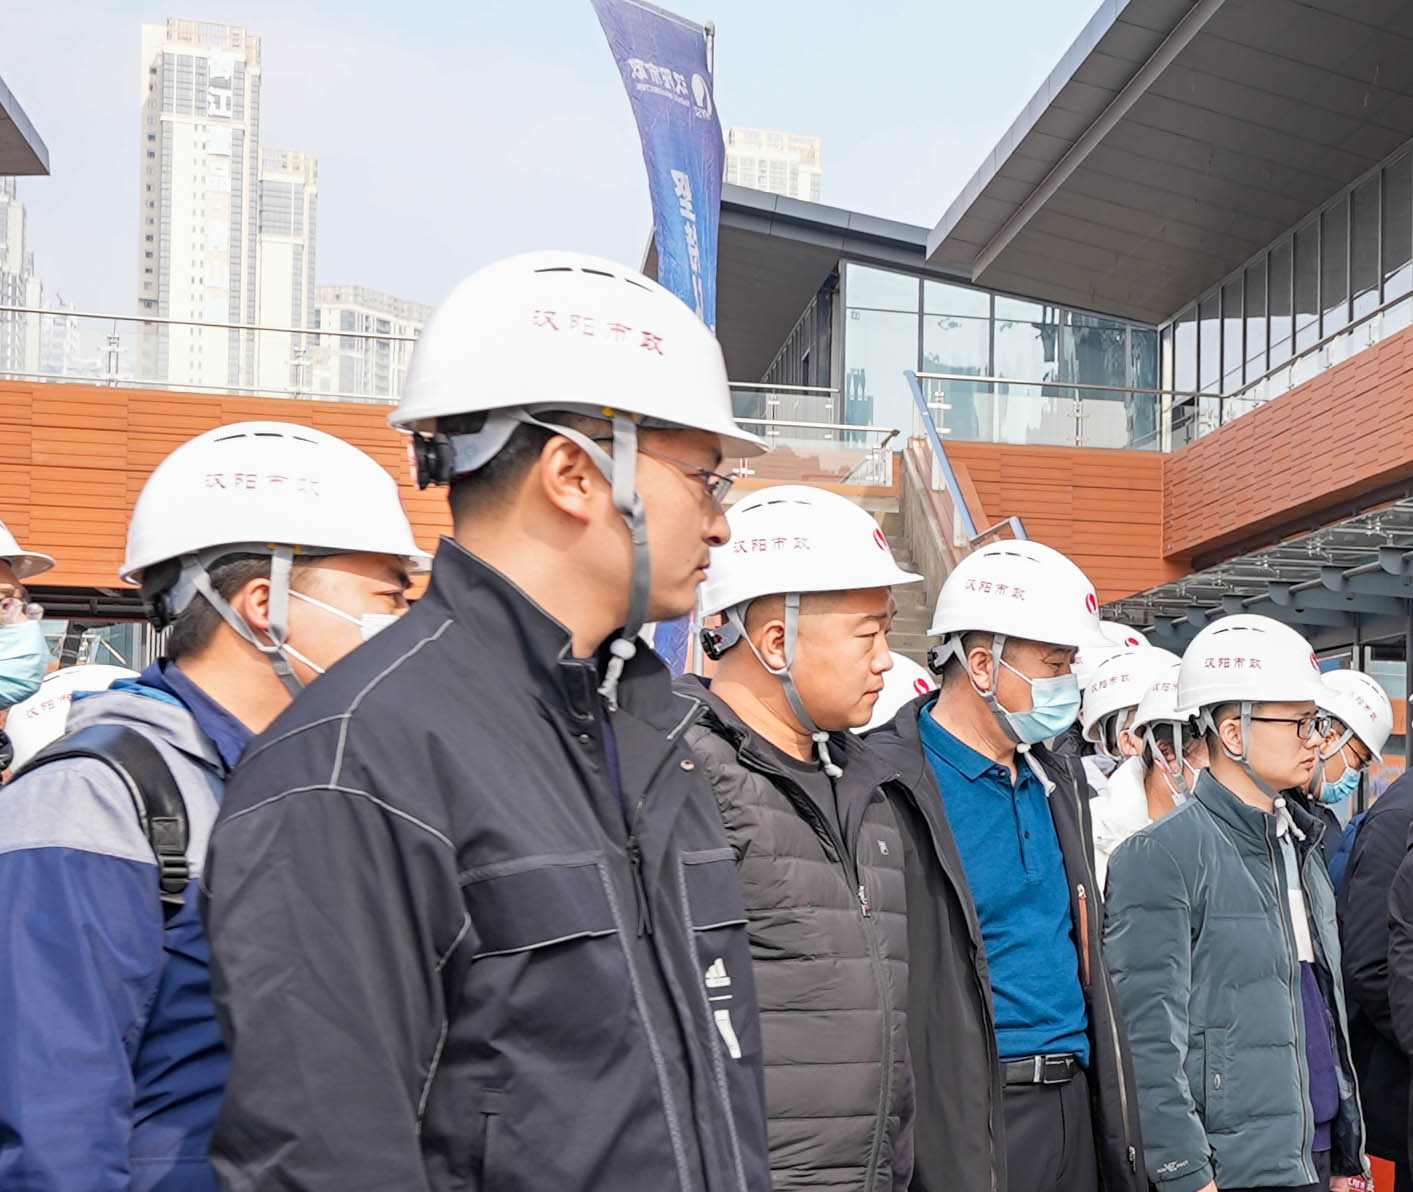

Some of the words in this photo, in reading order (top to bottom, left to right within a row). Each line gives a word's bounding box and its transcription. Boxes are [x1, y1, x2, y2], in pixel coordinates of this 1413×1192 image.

[533, 309, 664, 356] 汉阳市政
[733, 536, 811, 554] 汉阳市政
[965, 578, 1026, 601] 汉阳市政
[1204, 656, 1262, 670] 汉阳市政
